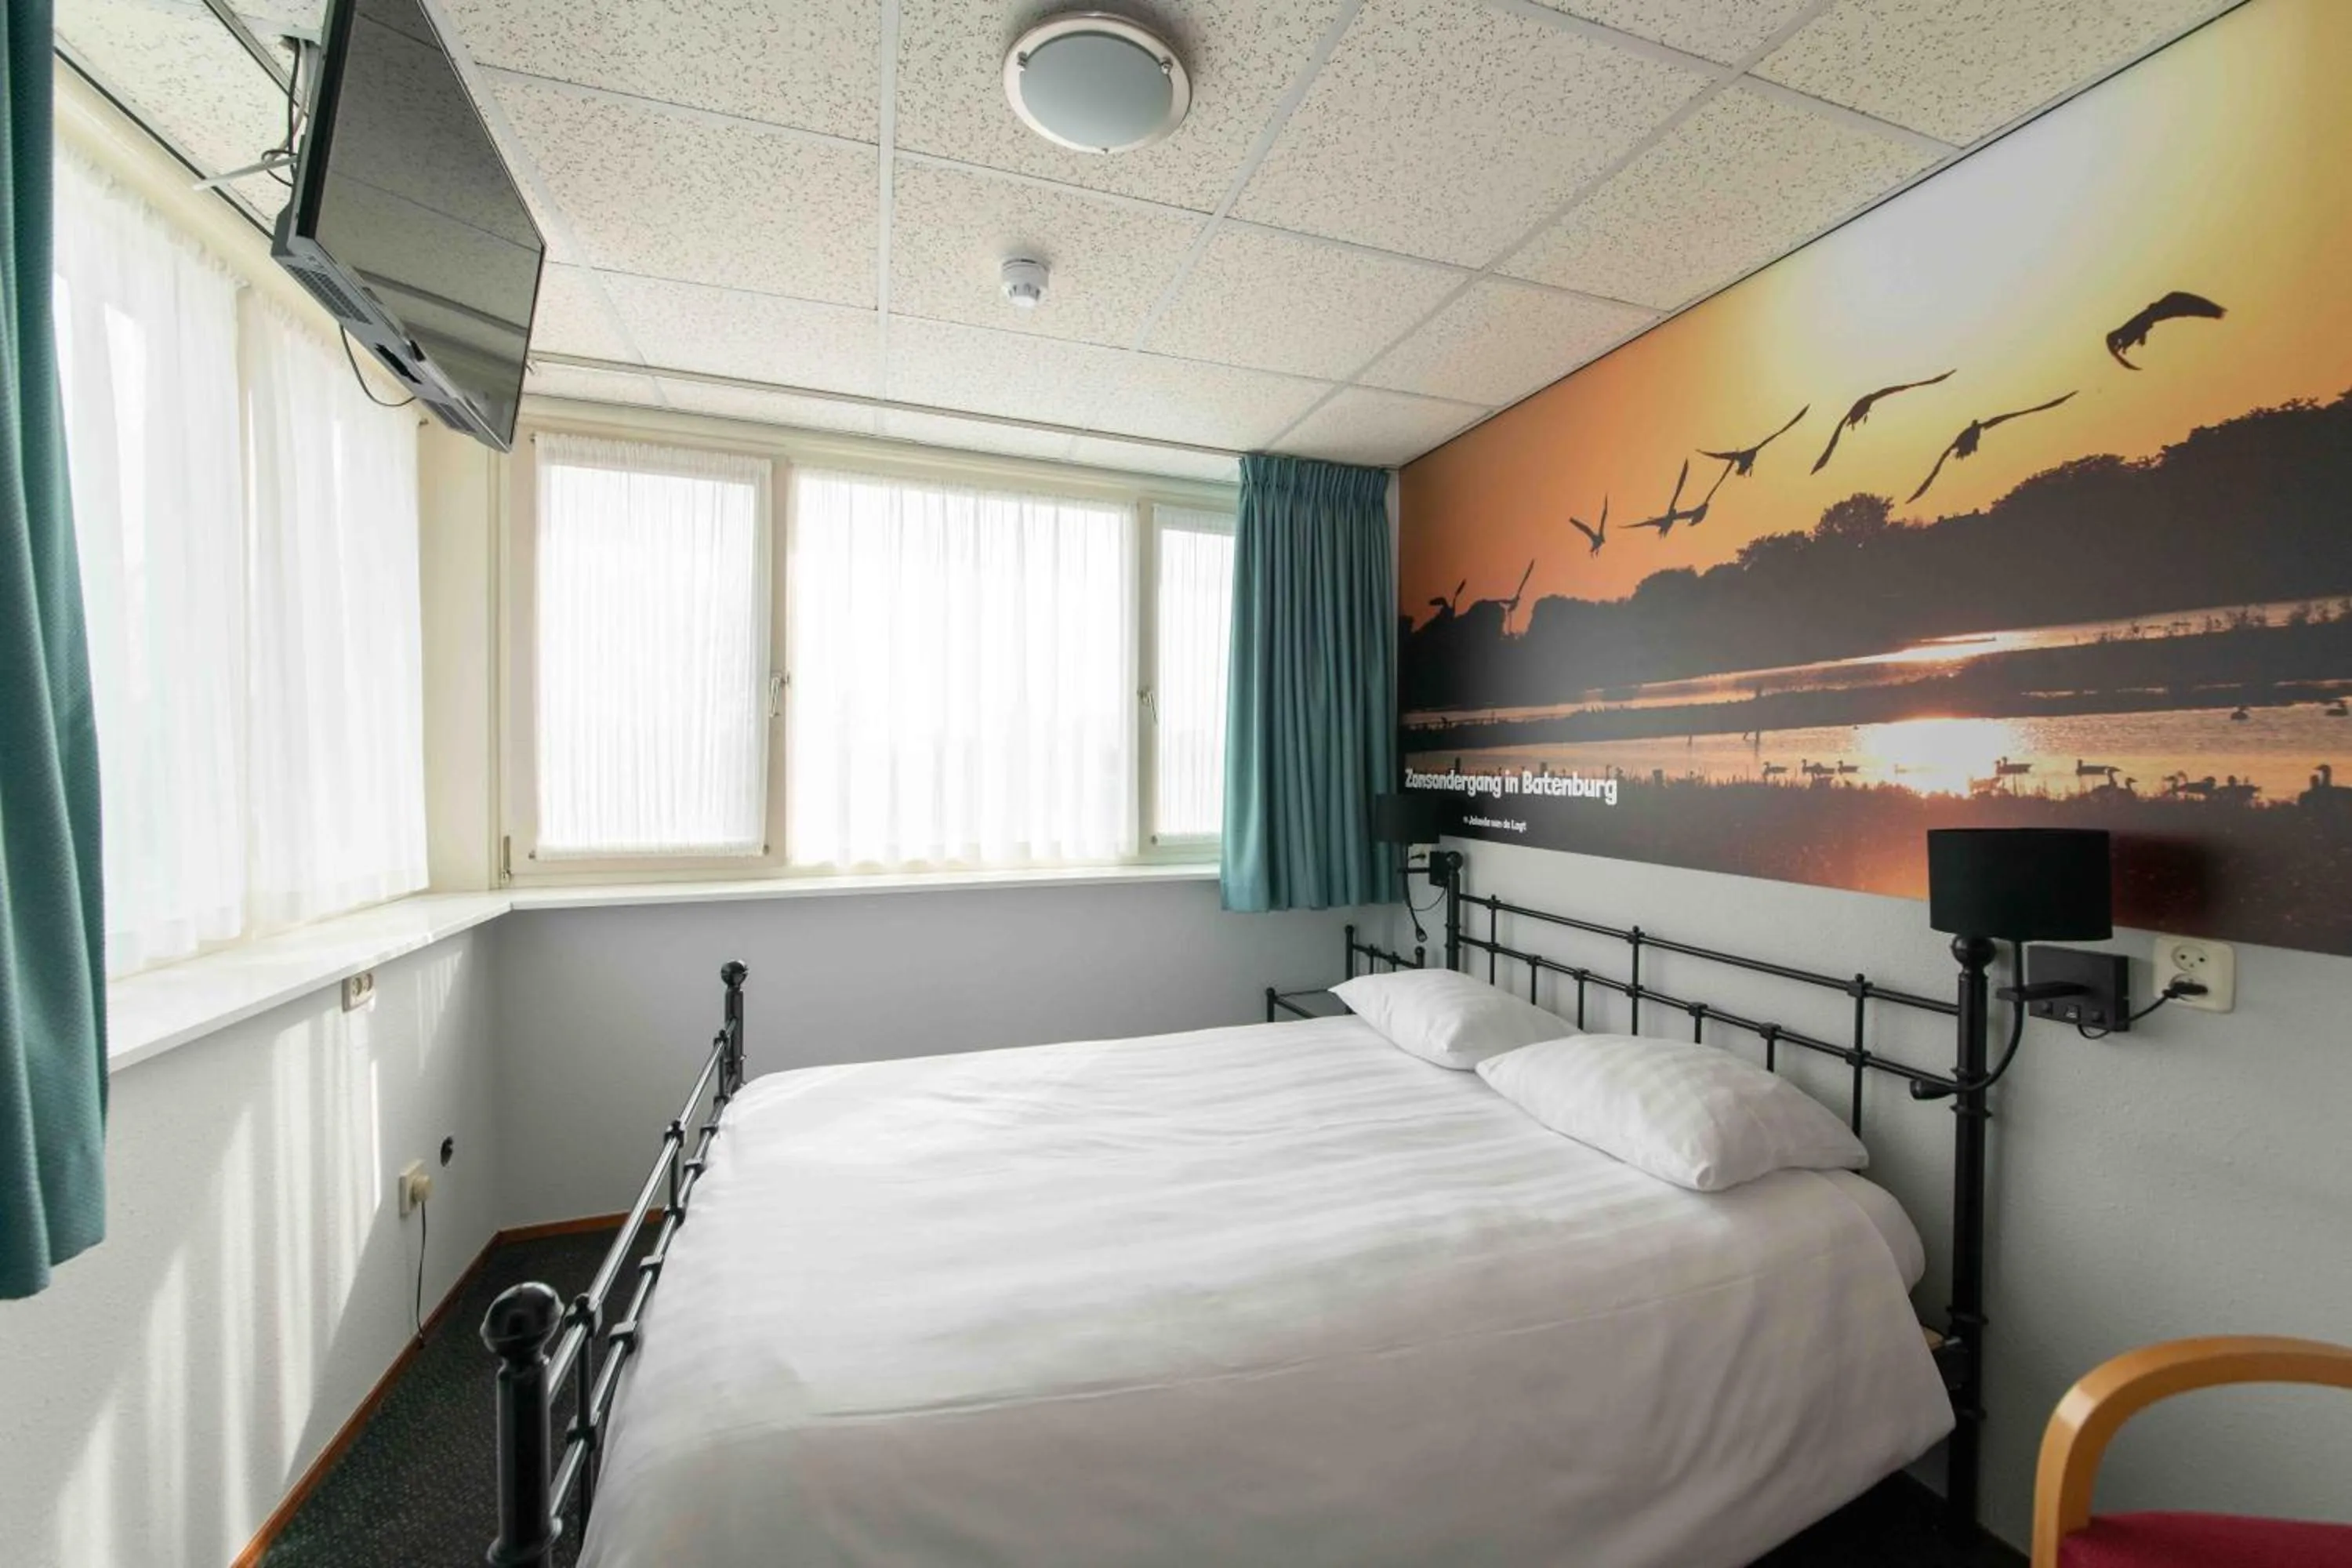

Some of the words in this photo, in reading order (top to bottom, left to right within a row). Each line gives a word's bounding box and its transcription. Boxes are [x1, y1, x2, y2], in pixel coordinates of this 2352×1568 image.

[1405, 768, 1501, 798] Zonsondergang
[1504, 770, 1519, 793] in
[1522, 771, 1617, 805] Batenburg
